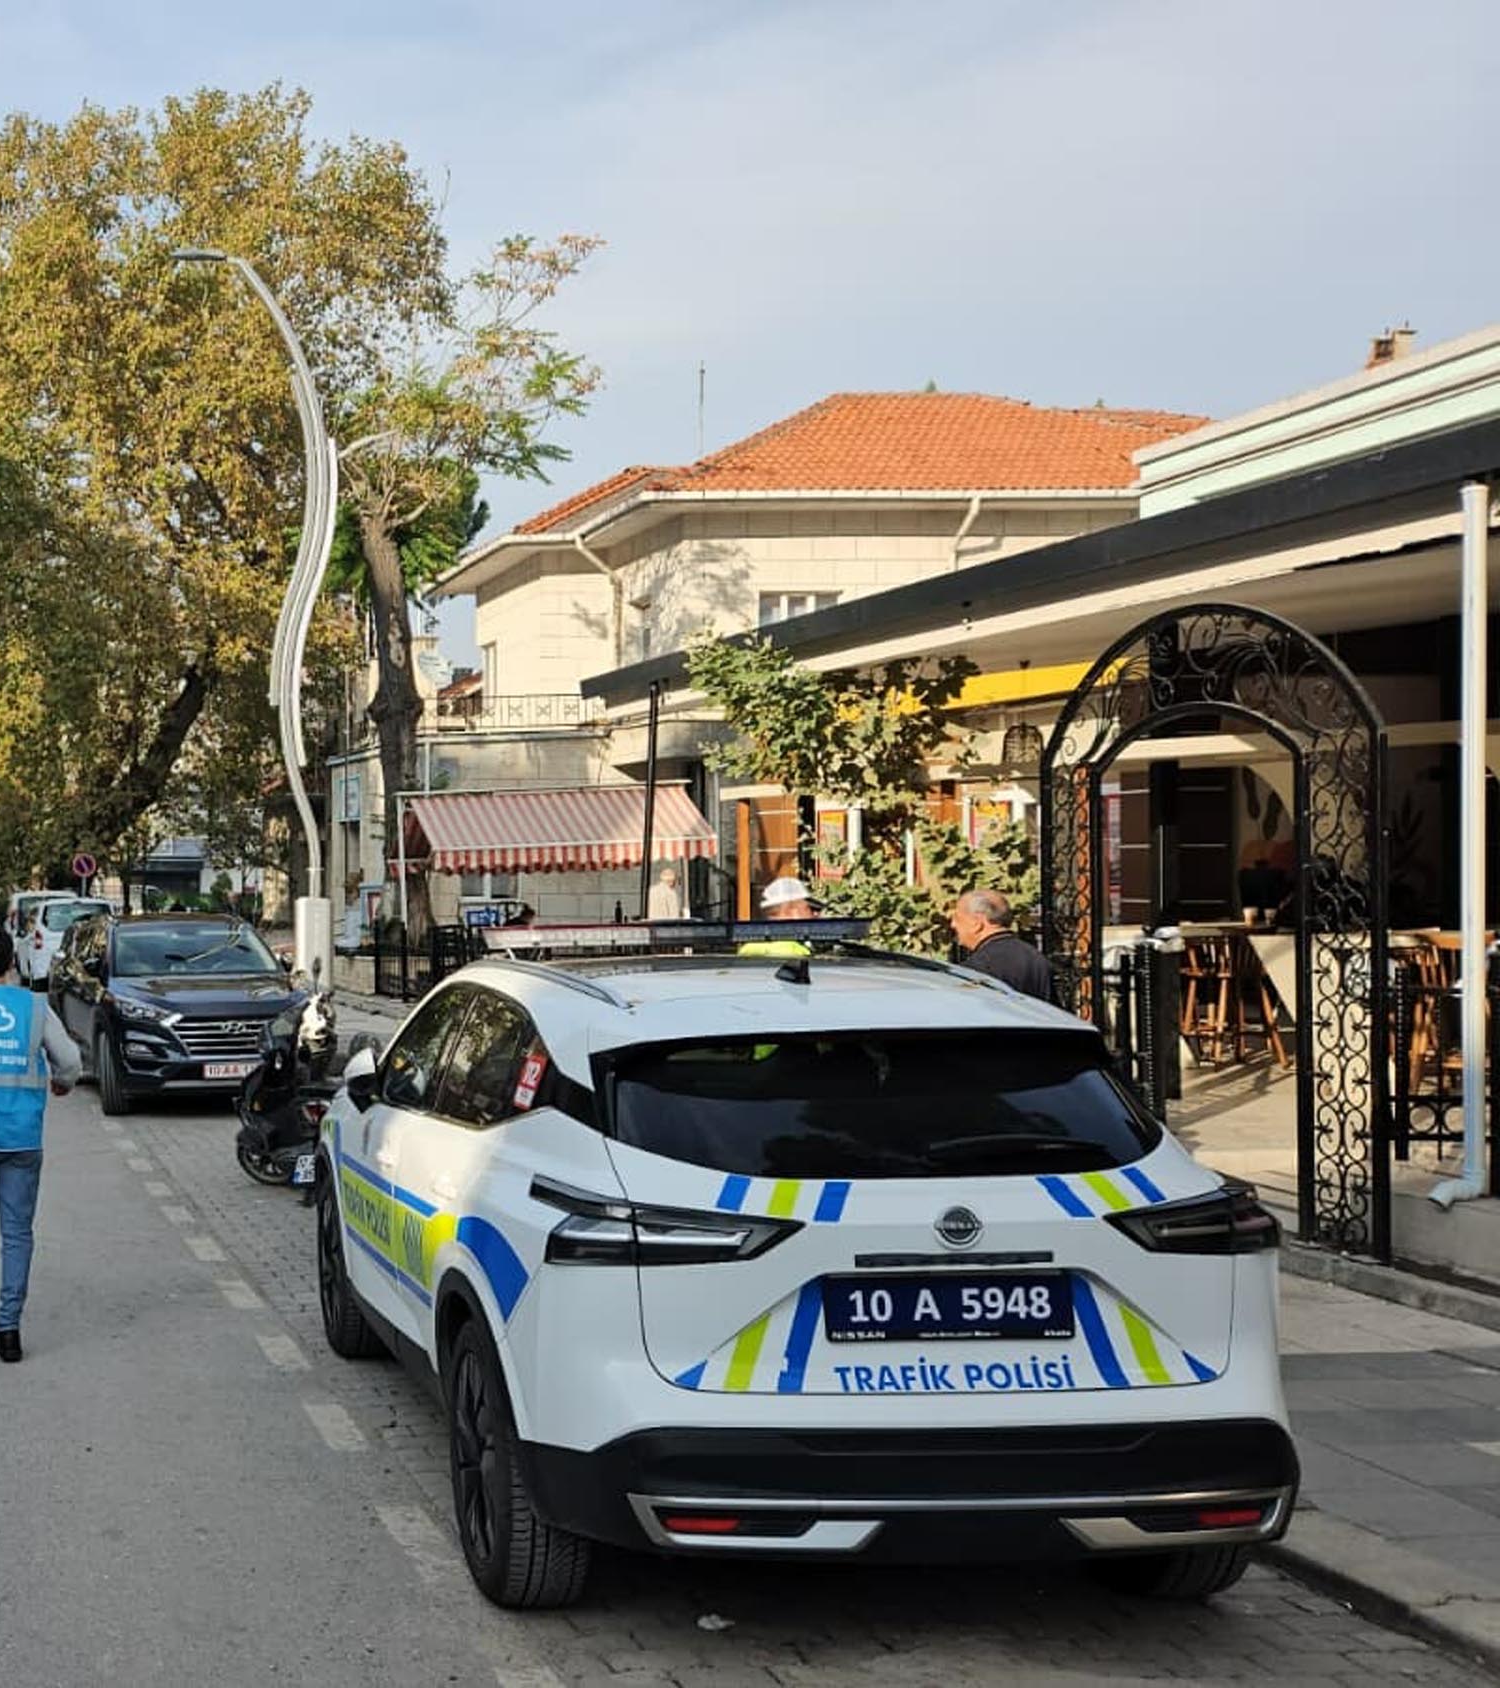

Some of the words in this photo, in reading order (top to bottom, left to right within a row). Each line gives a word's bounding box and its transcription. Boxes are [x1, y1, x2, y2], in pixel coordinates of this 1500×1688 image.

[849, 1289, 894, 1323] 10
[913, 1288, 943, 1322] A
[960, 1286, 1052, 1320] 5948
[834, 1357, 956, 1393] TRAFİK
[963, 1355, 1076, 1390] POLİSİ
